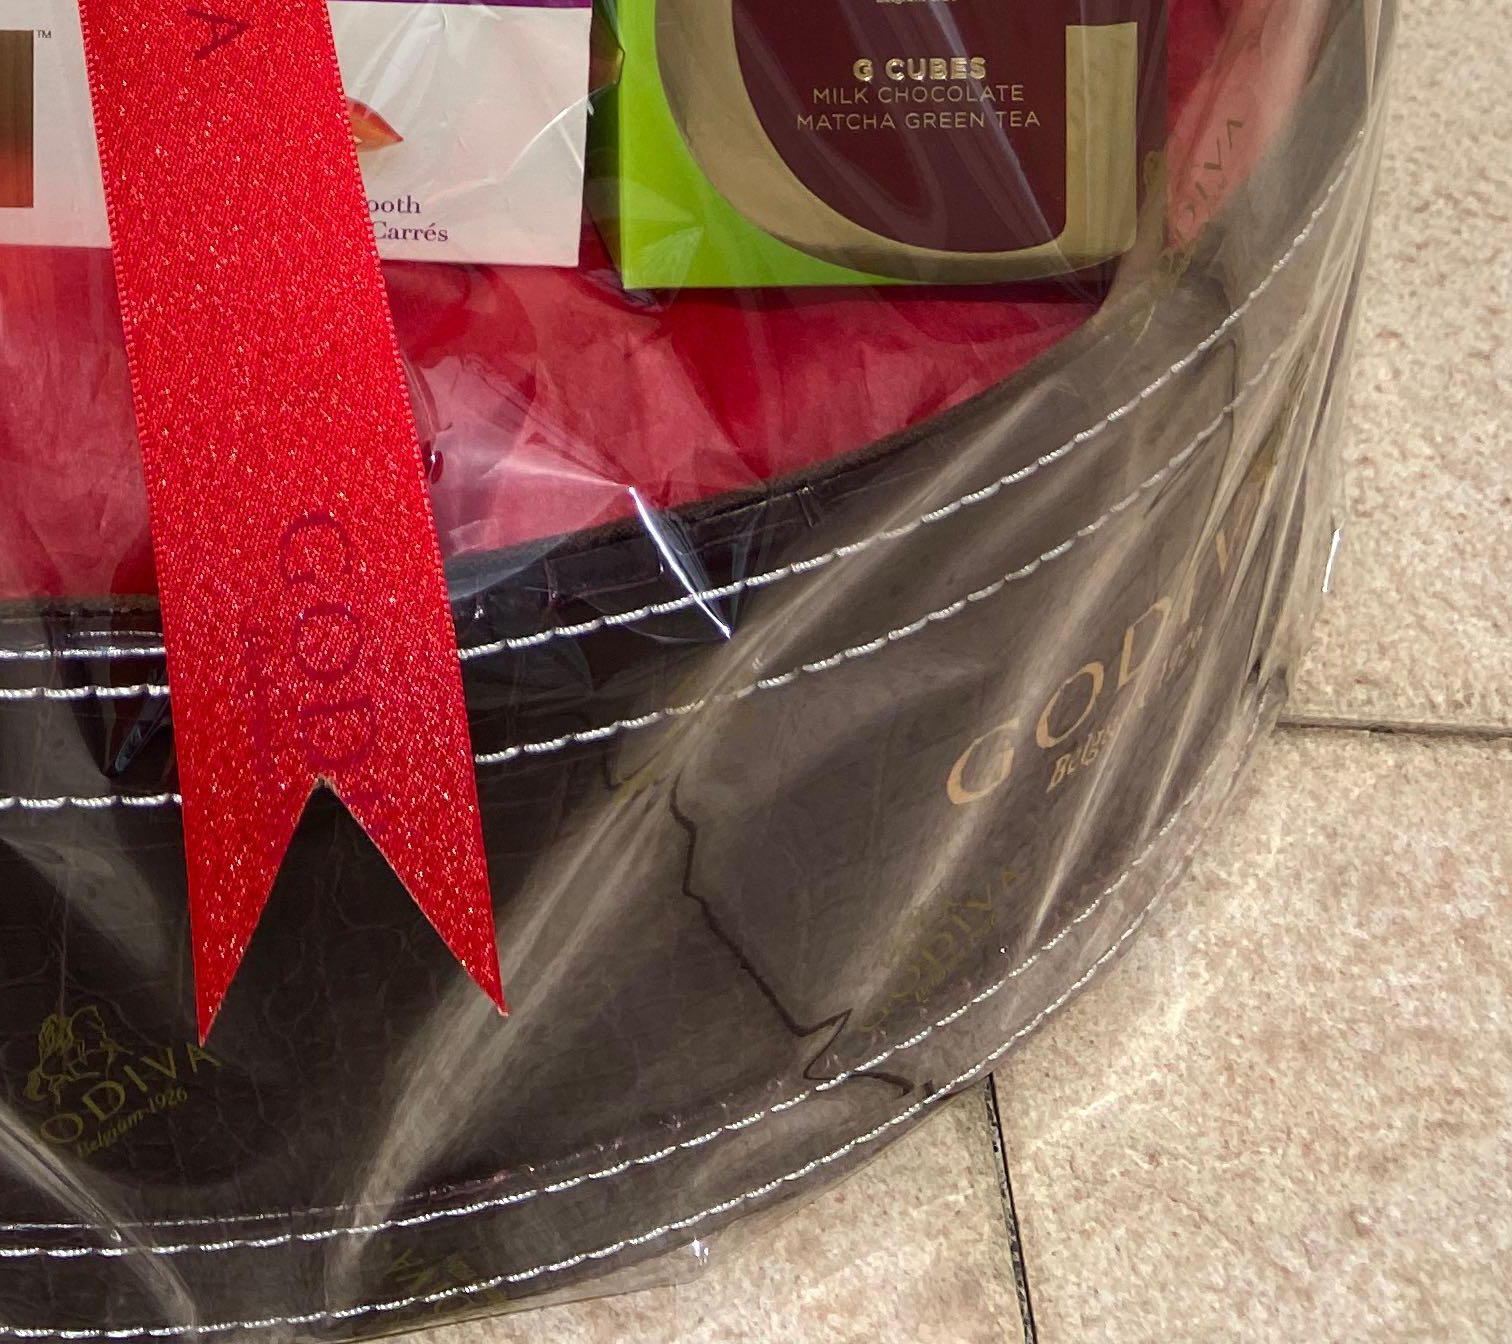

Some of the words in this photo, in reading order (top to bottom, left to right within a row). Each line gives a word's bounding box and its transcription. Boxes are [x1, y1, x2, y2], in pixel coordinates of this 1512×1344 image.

[853, 58, 873, 81] G
[886, 56, 986, 81] CUBES
[812, 87, 869, 105] MILK
[879, 84, 1025, 104] CHOCOLATE
[796, 113, 896, 131] MATCHA
[904, 112, 988, 130] GREEN
[995, 110, 1041, 129] TEA
[368, 194, 422, 214] ooth
[39, 1041, 226, 1145] ODIVA
[148, 1085, 187, 1111] 1926
